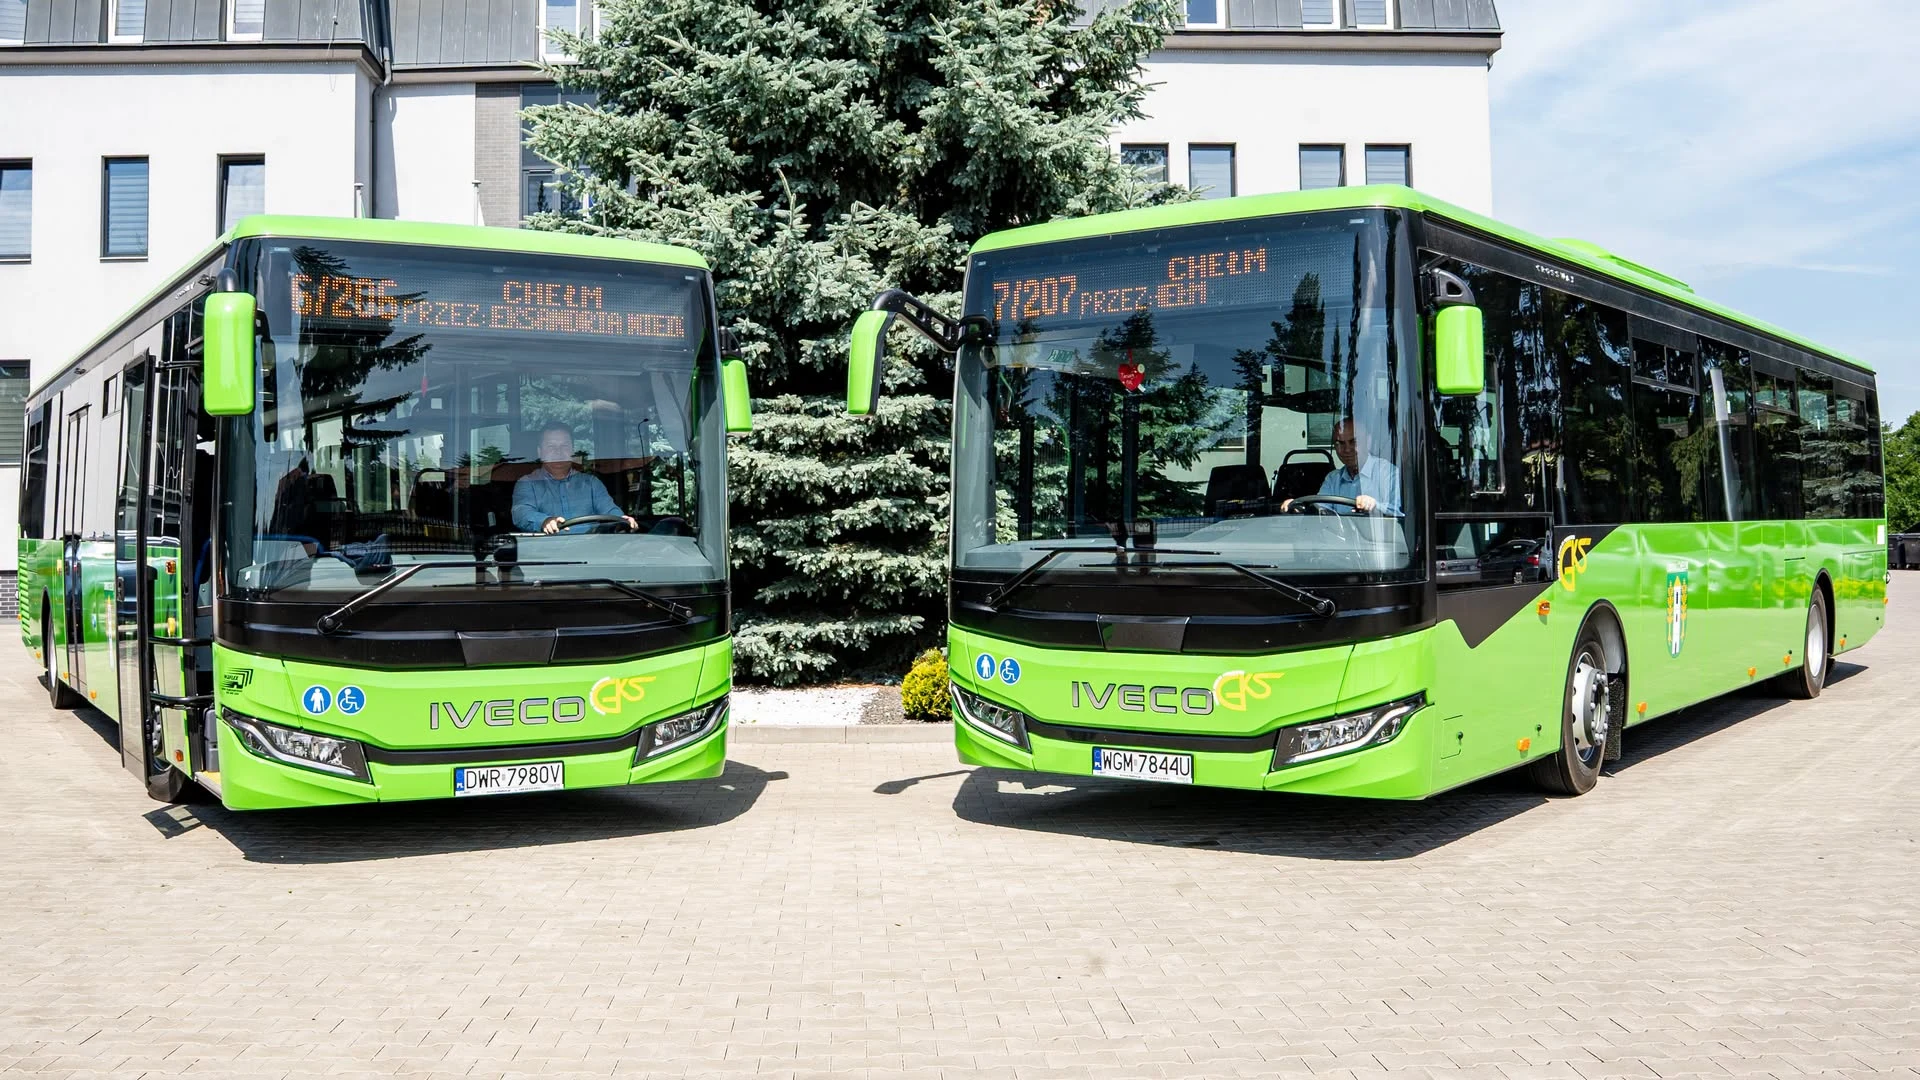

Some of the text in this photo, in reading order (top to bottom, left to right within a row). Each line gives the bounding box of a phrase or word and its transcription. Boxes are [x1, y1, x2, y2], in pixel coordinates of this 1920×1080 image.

[291, 274, 398, 319] 6/206
[993, 275, 1077, 320] 7/207
[430, 696, 585, 730] IVECO
[1072, 681, 1214, 715] IVECO
[466, 769, 501, 789] DWR
[507, 764, 560, 787] 7980V
[1103, 751, 1133, 772] WGM
[1138, 754, 1190, 776] 7844U
